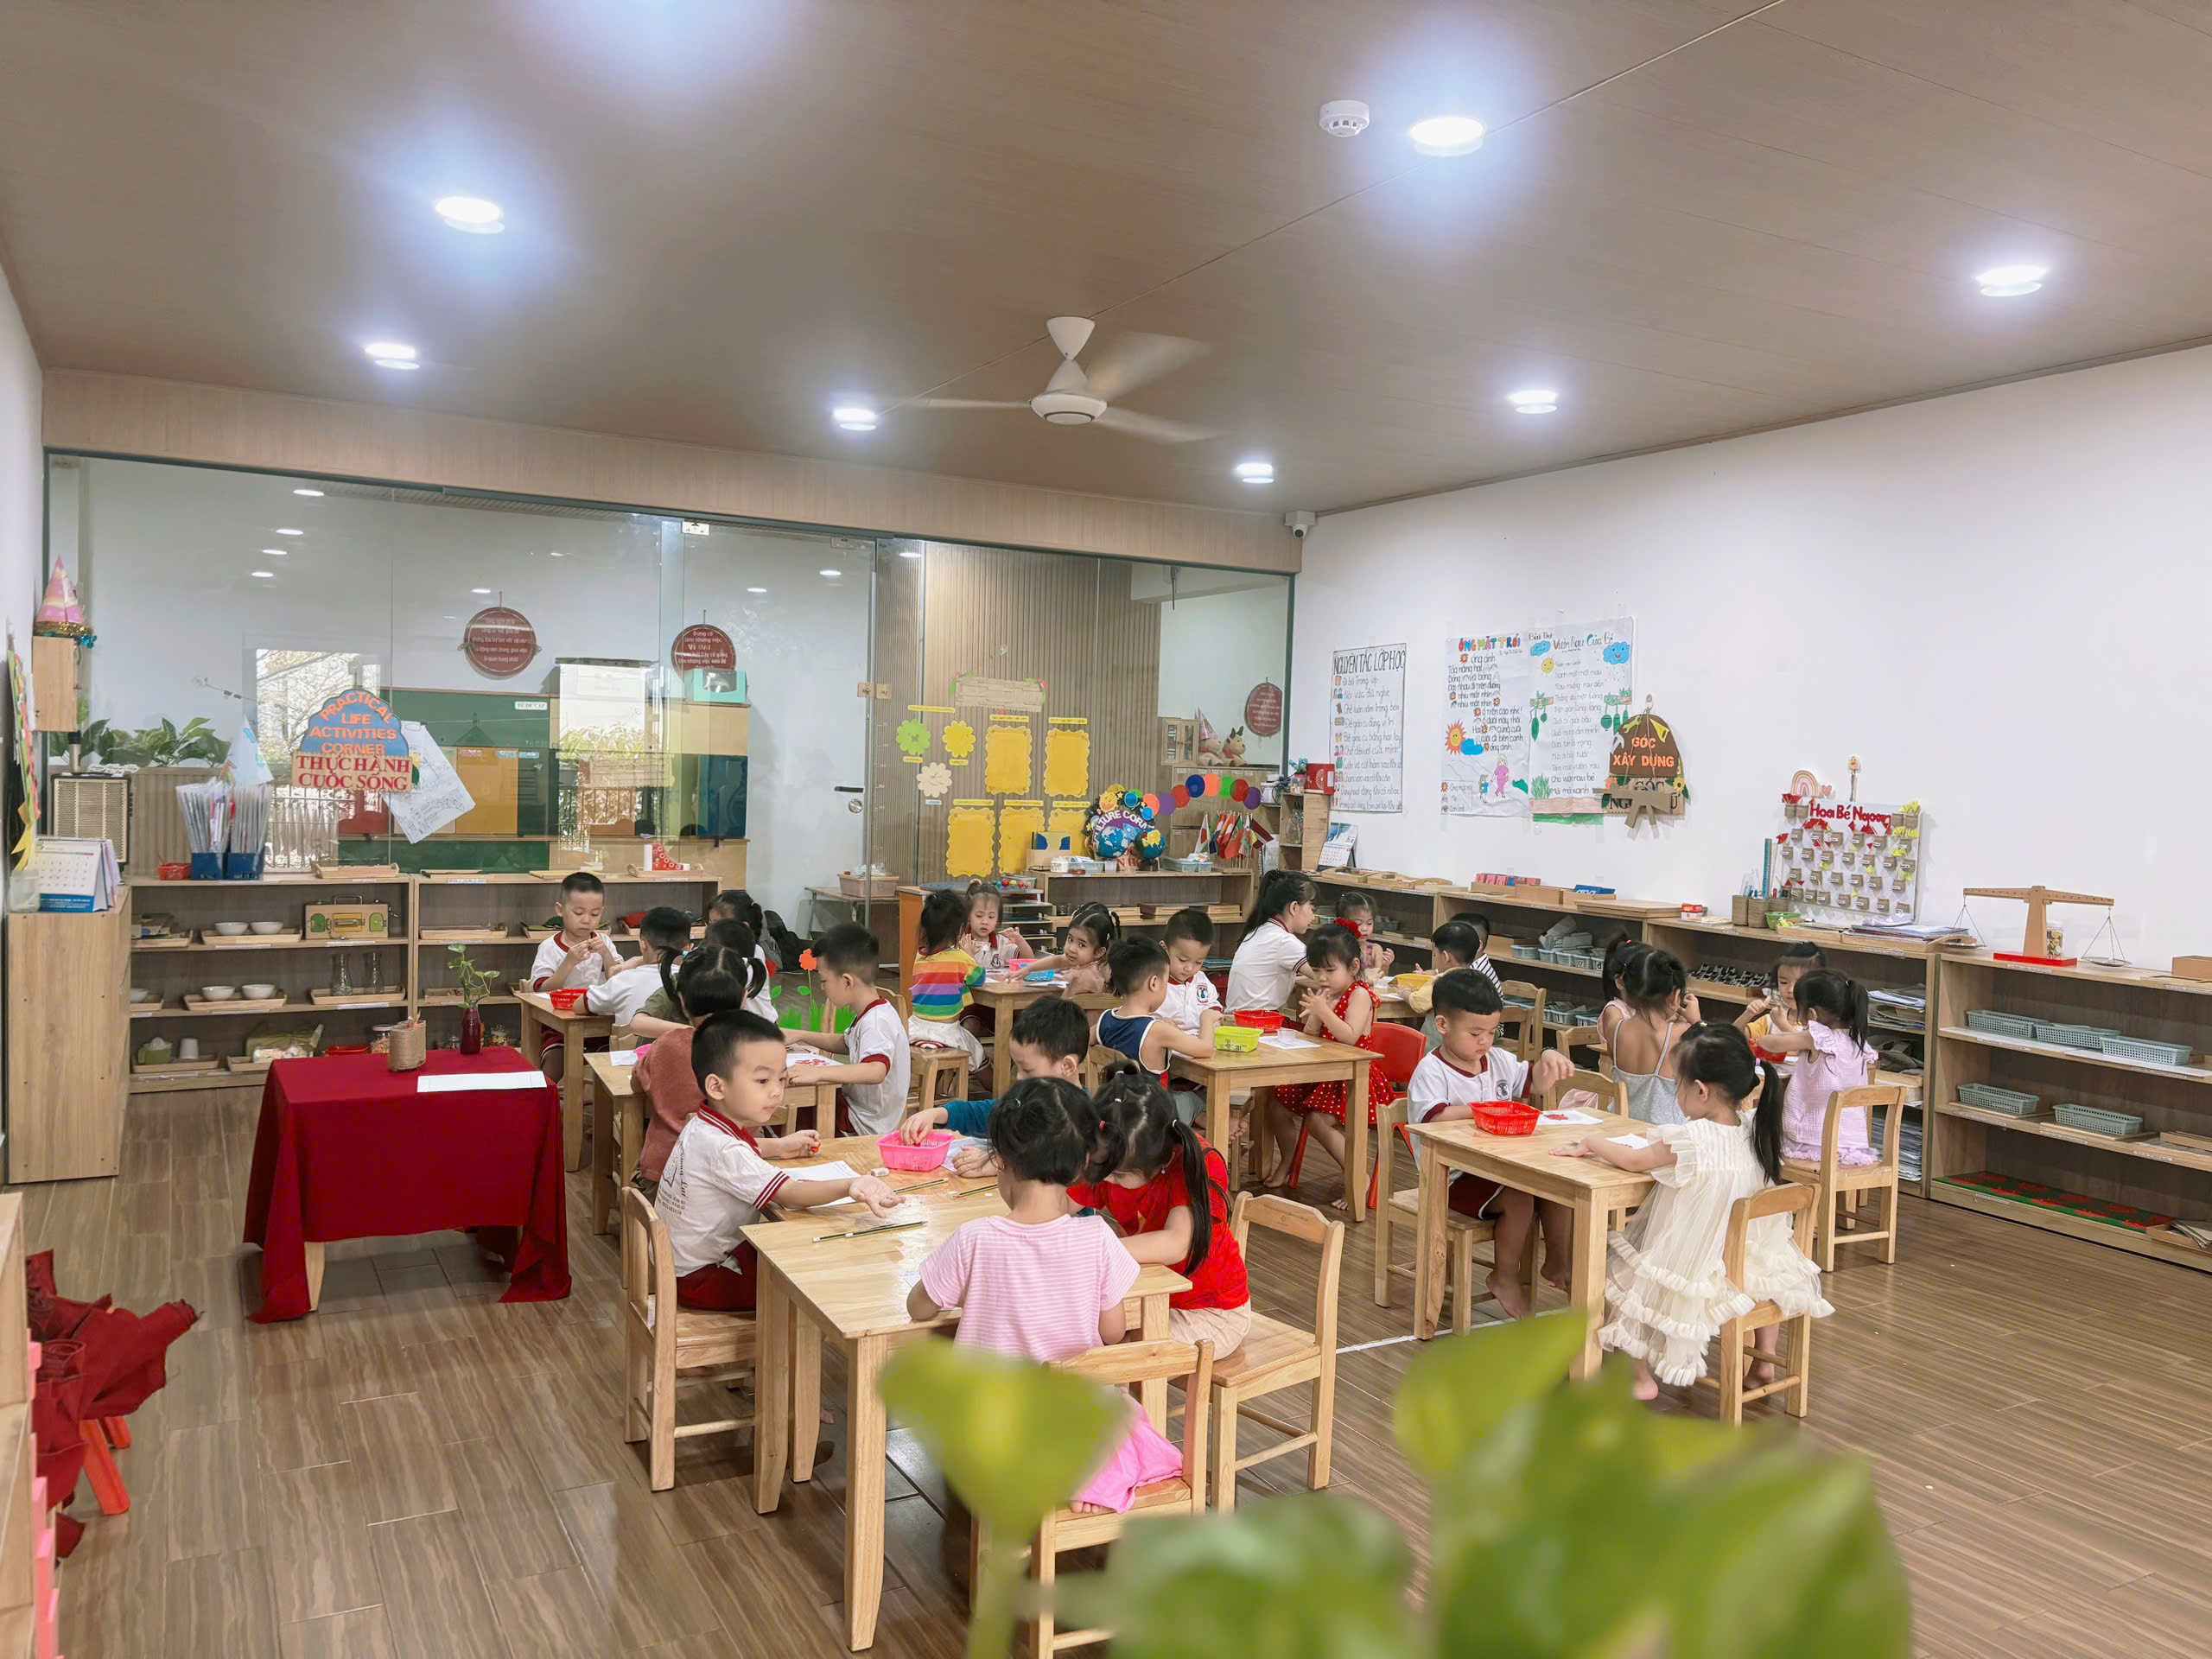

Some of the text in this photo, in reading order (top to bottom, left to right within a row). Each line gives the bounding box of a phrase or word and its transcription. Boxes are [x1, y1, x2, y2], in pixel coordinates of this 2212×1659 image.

[1459, 638, 1476, 652] ÔNG
[319, 691, 393, 724] PRACTICAL
[340, 713, 372, 725] LIFE
[309, 725, 397, 740] ACTIVITIES
[1631, 734, 1656, 748] GÓC
[321, 742, 385, 755] CORNER
[296, 754, 410, 773] THỰC HÀNH
[1613, 752, 1636, 766] XÂY
[298, 771, 407, 791] CUỘC SỐNG
[1809, 803, 1834, 818] Hoa
[1836, 804, 1851, 820] Bé
